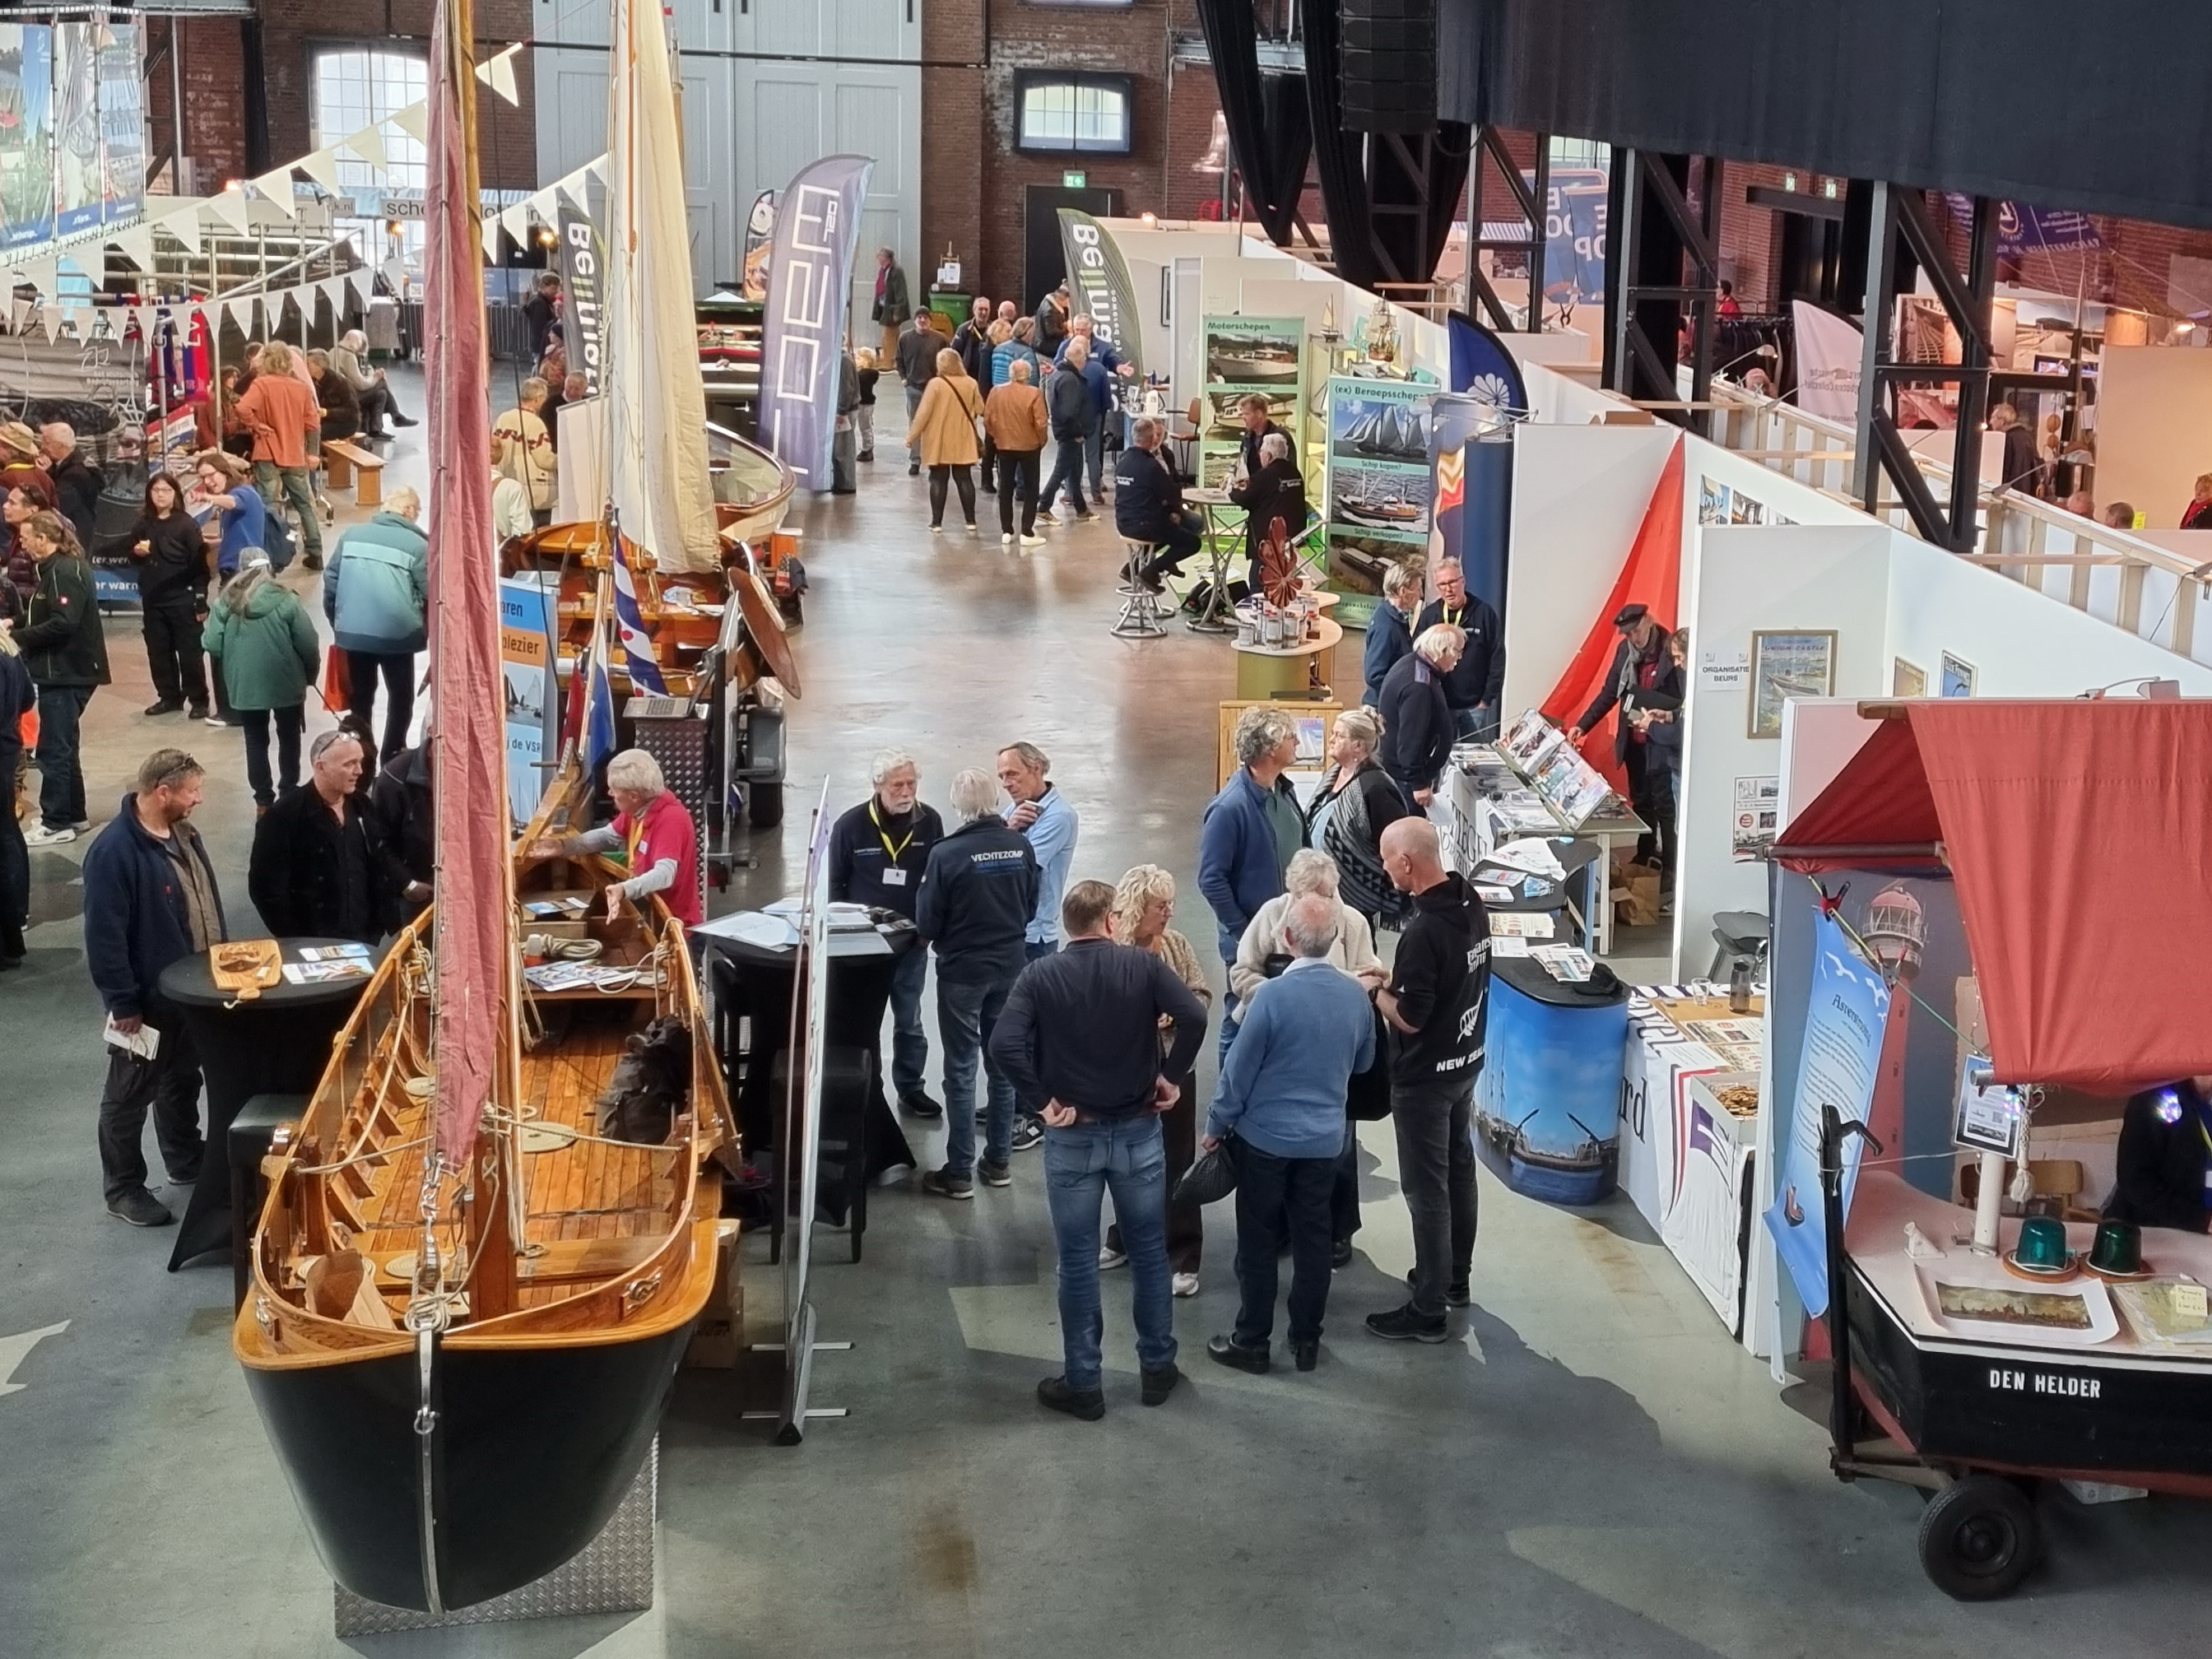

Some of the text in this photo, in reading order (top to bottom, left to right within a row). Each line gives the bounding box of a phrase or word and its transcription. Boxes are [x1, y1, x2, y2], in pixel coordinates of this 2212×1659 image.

[1207, 322, 1271, 331] Motorschepen
[1335, 384, 1430, 402] (ex) Beroepsschep
[512, 738, 523, 750] de
[1436, 1045, 1486, 1072] NEW ZEAL
[1989, 1369, 2101, 1399] DEN HELDER
